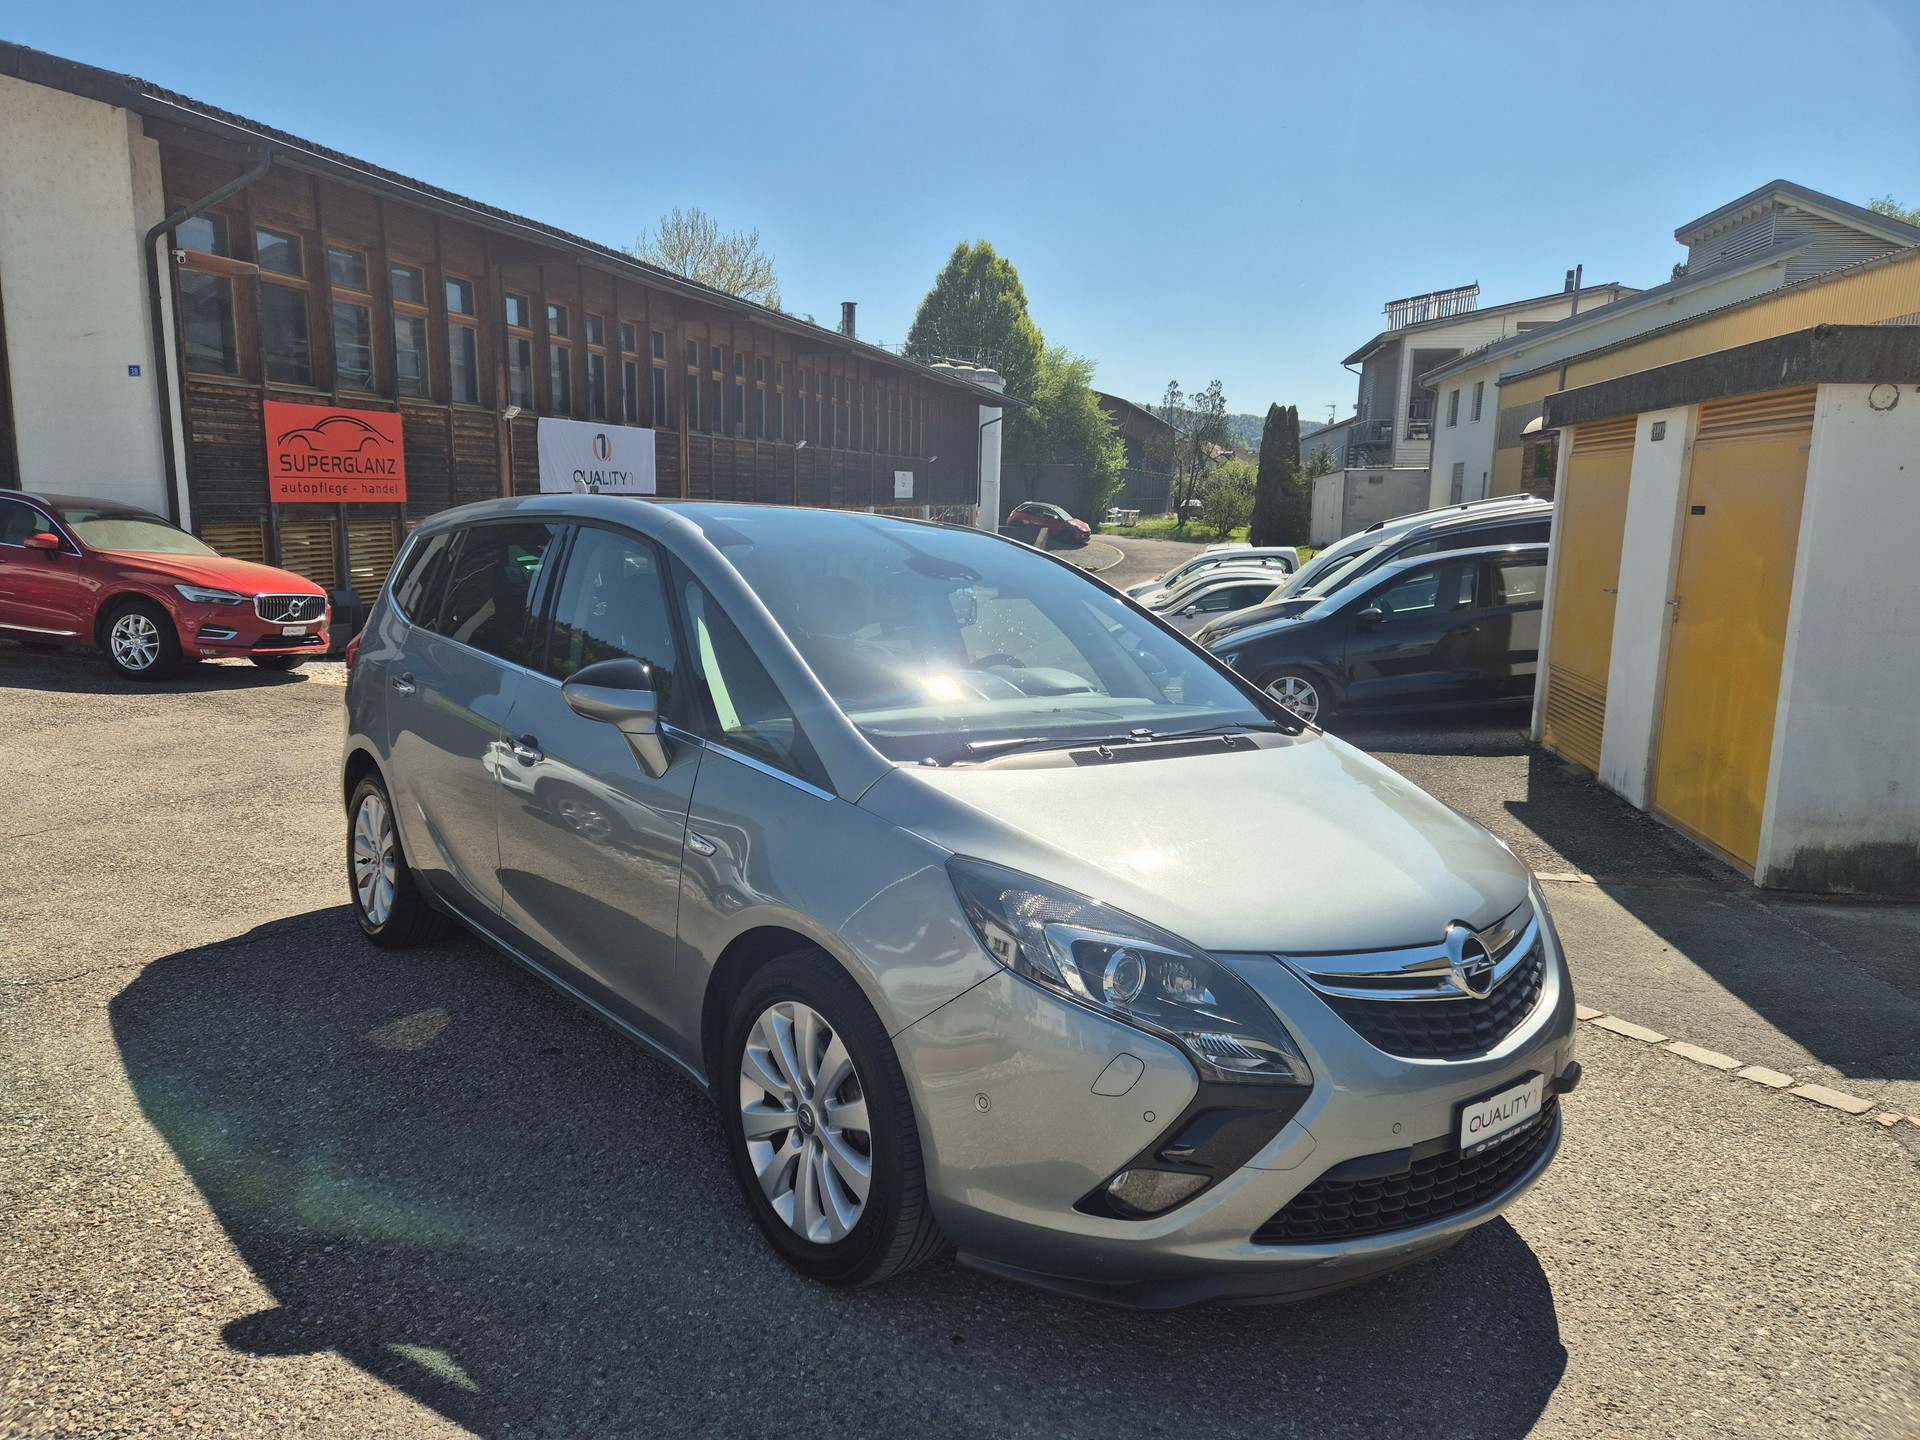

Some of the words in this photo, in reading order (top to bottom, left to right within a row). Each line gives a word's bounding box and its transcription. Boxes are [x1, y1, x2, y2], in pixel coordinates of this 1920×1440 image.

[279, 453, 396, 475] SUPERGLANZ
[573, 469, 627, 485] QUALITY
[281, 482, 348, 496] autopflege
[361, 483, 398, 494] handel
[1469, 1092, 1532, 1133] QUALITY
